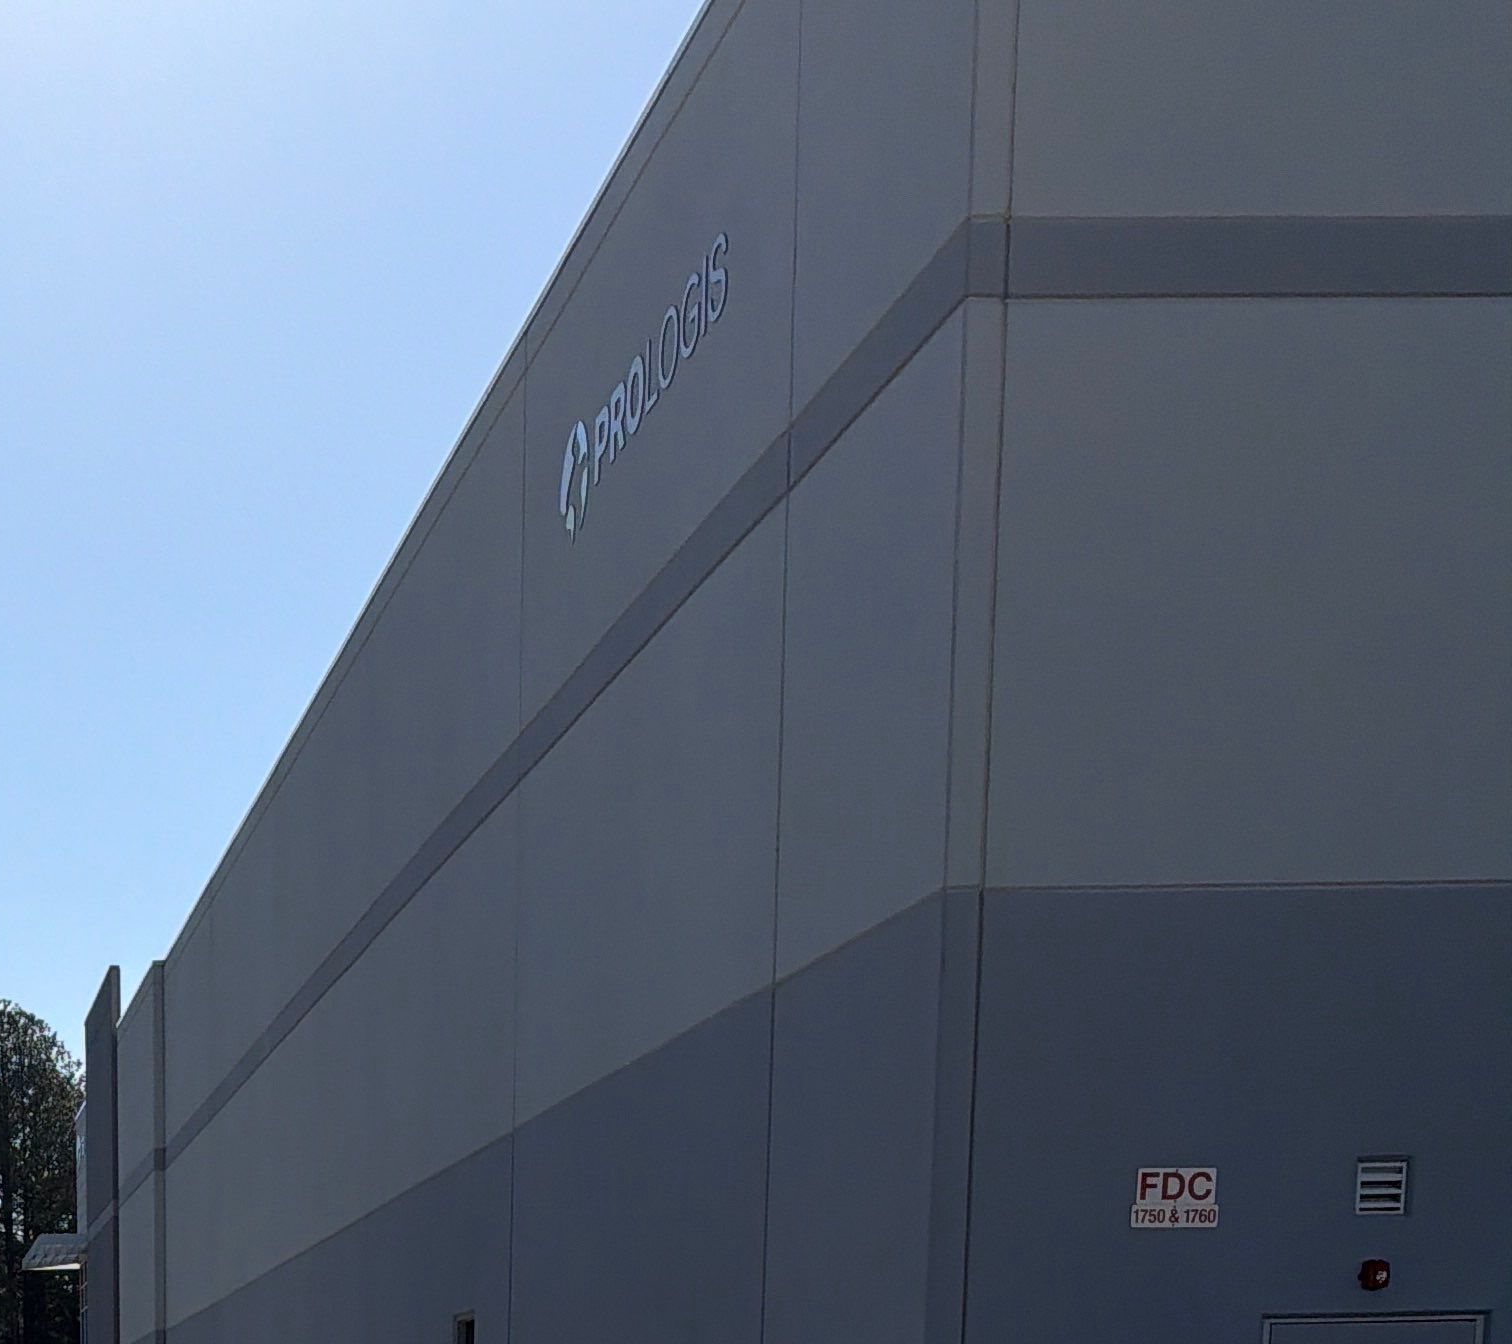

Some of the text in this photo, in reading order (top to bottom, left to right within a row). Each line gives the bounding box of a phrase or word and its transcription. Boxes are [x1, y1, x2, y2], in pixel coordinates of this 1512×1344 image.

[593, 232, 729, 487] PROLOGIS
[1139, 1172, 1213, 1201] FDC
[1133, 1208, 1217, 1224] 1750 & 1760
